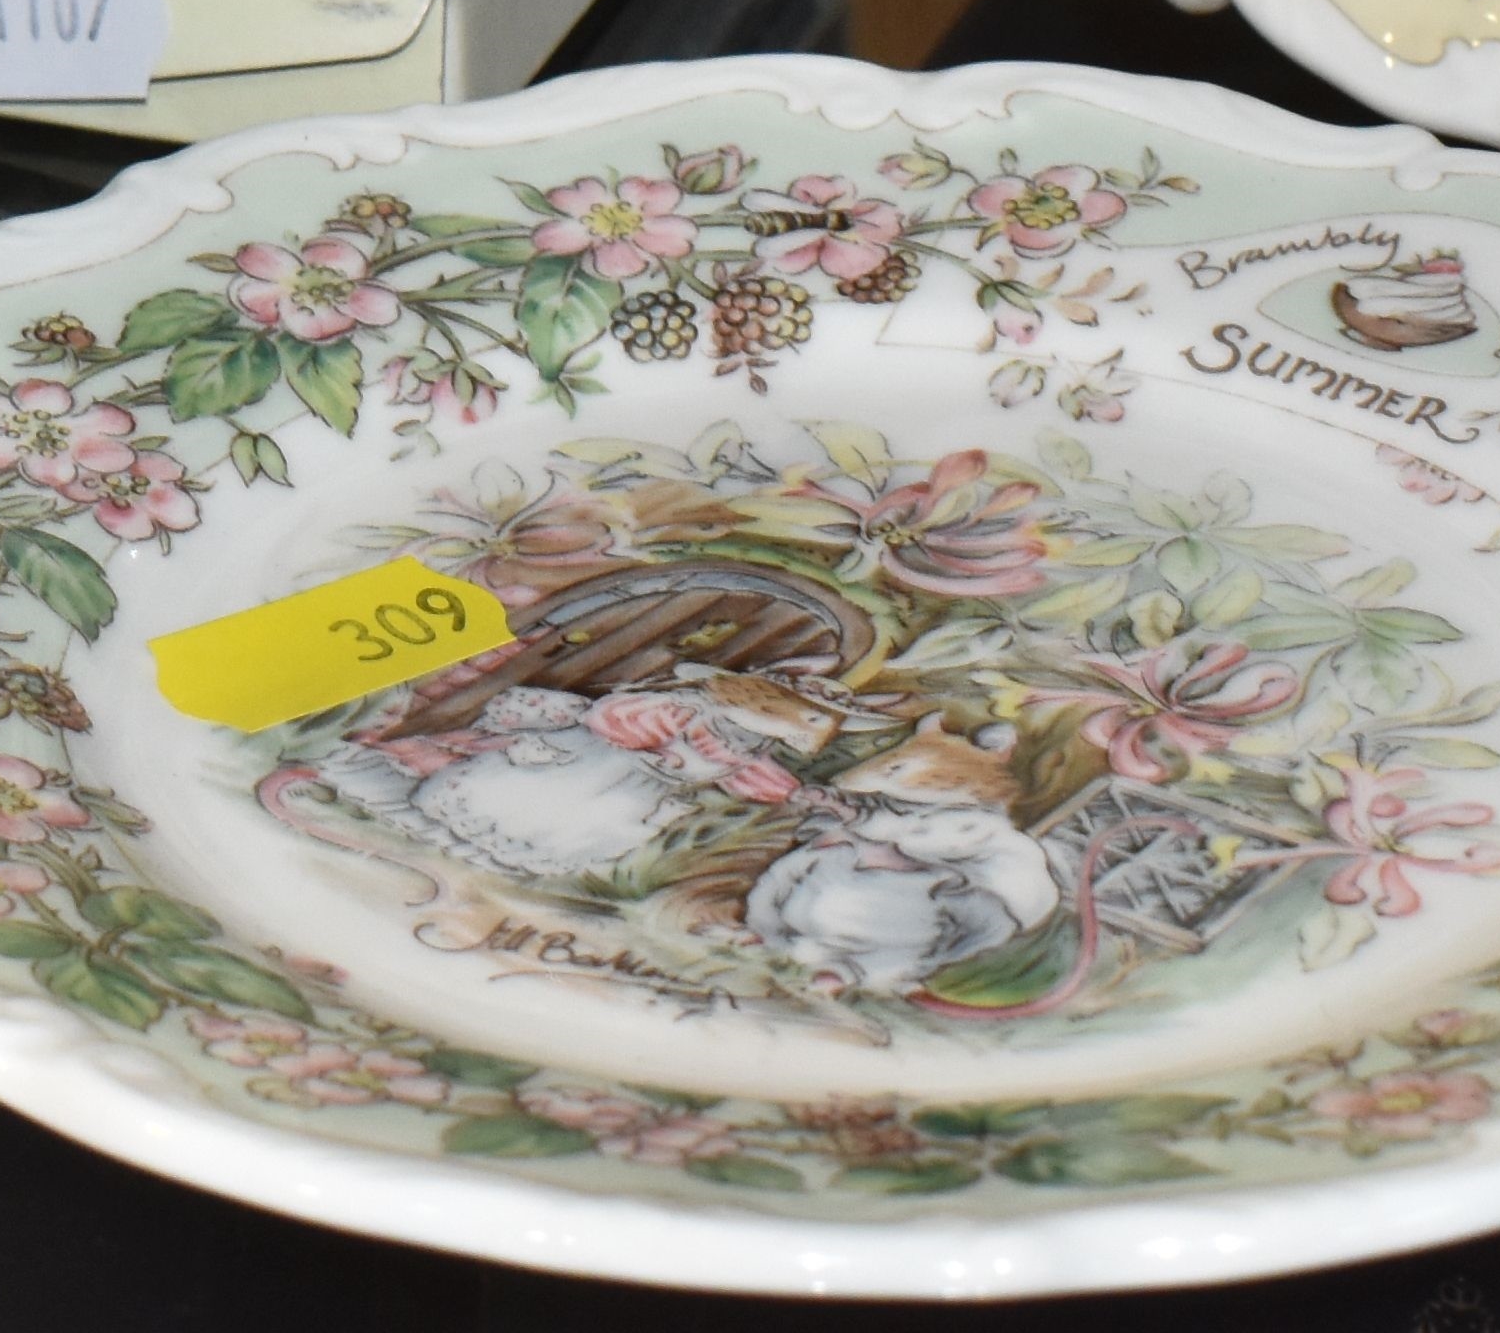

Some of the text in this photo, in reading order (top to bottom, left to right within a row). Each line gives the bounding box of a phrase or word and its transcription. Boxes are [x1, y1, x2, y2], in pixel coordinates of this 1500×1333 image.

[1174, 223, 1401, 290] Brambly
[1178, 323, 1481, 444] SUMMER
[327, 585, 470, 665] 309
